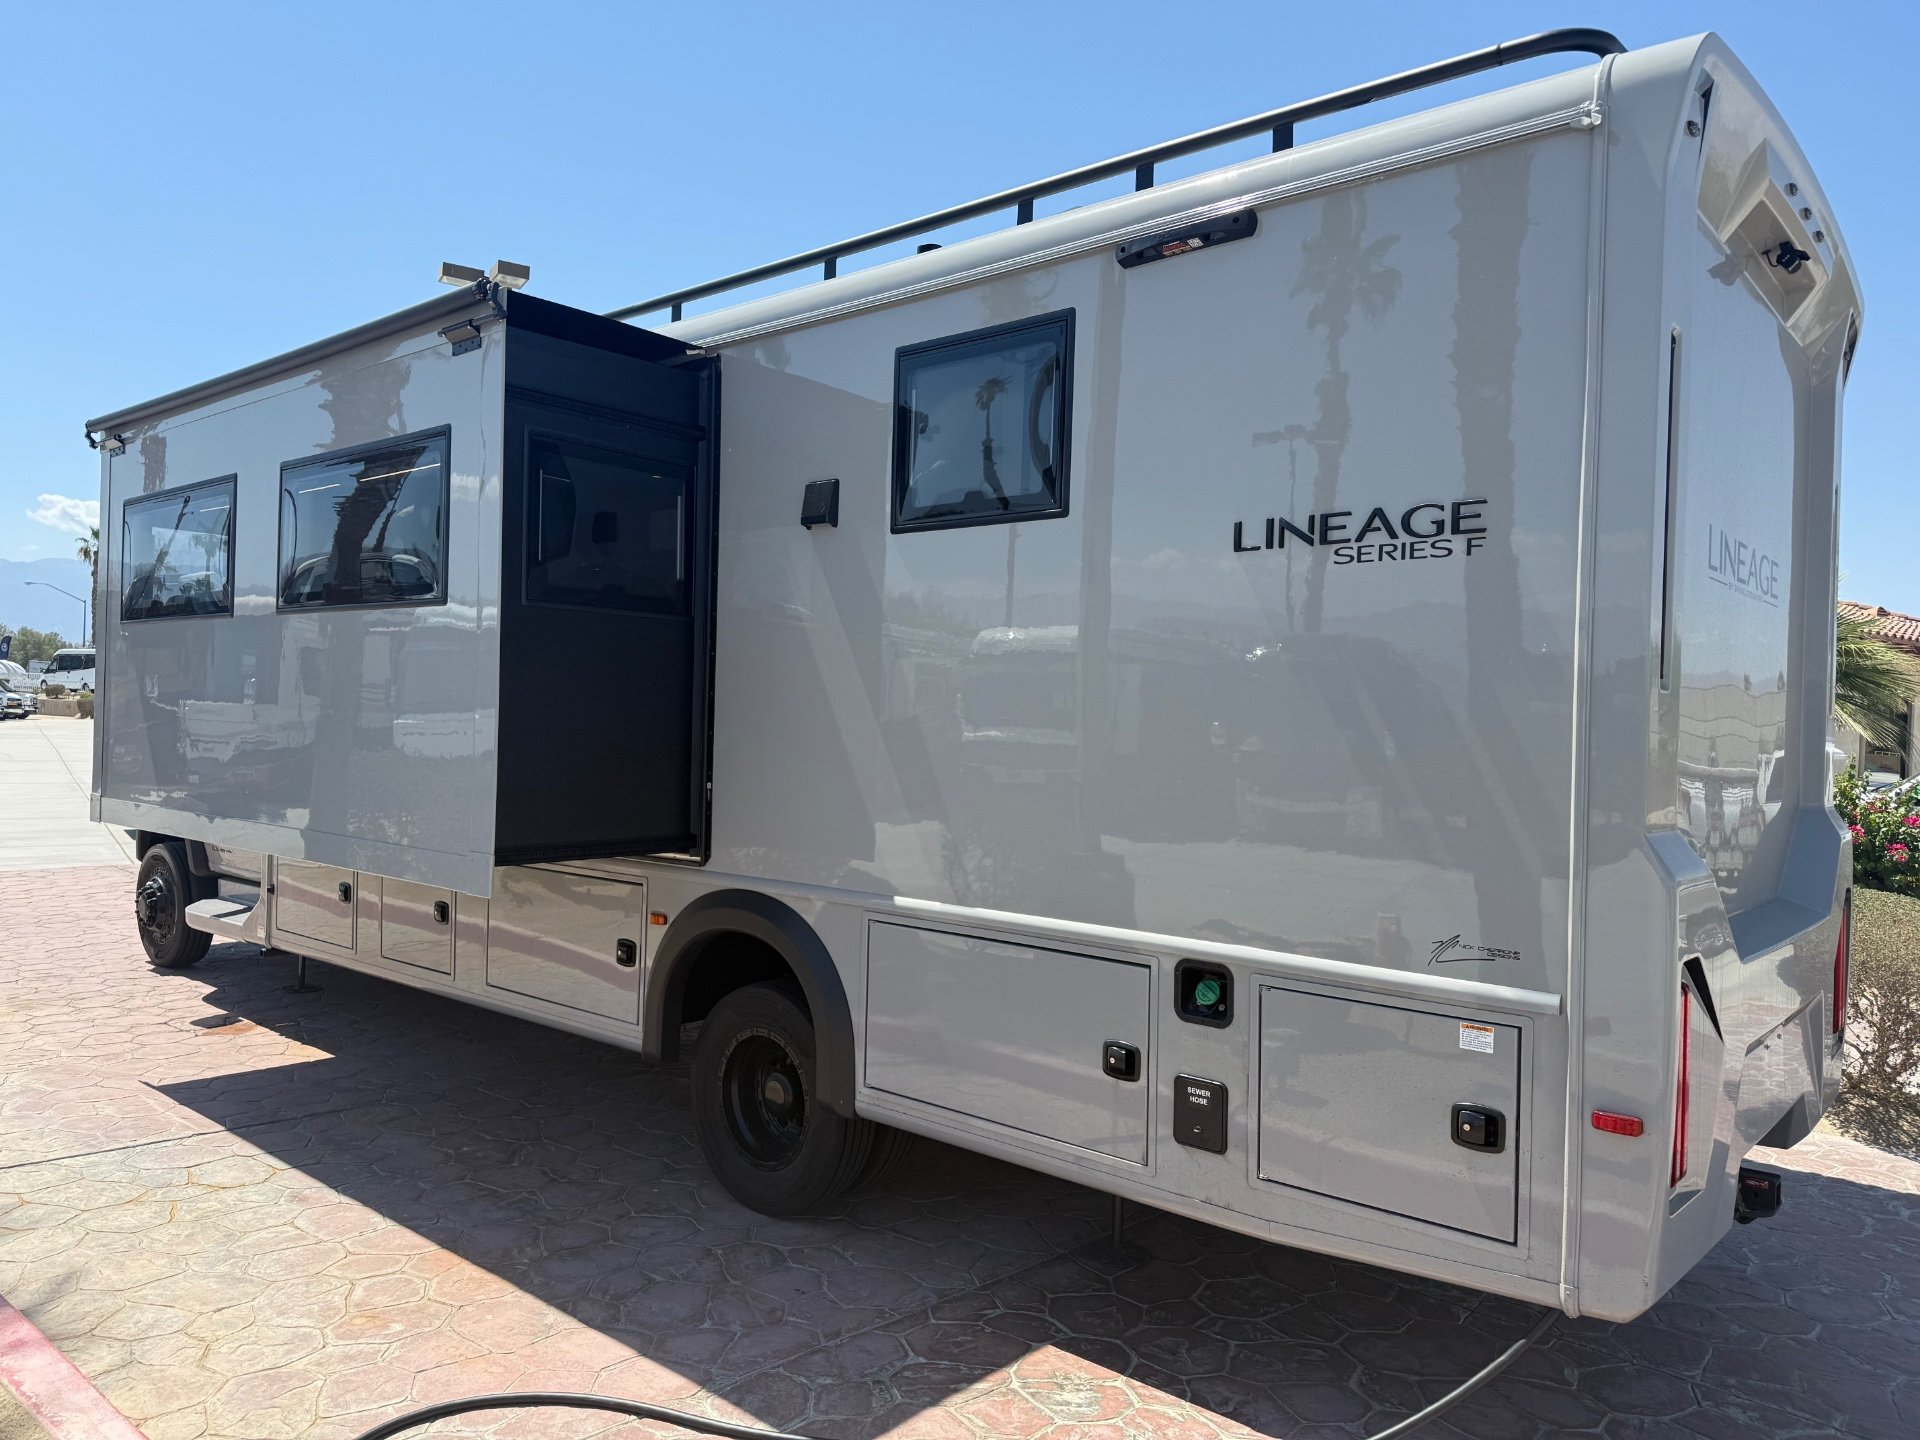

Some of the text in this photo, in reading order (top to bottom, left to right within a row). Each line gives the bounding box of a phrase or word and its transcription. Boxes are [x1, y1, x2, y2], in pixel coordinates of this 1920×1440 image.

[1233, 498, 1488, 553] LINEAGE
[1333, 536, 1487, 565] SERIES F
[1708, 523, 1779, 600] LINEAGE
[1187, 1086, 1211, 1098] SEWER
[1189, 1095, 1209, 1106] HOSE
